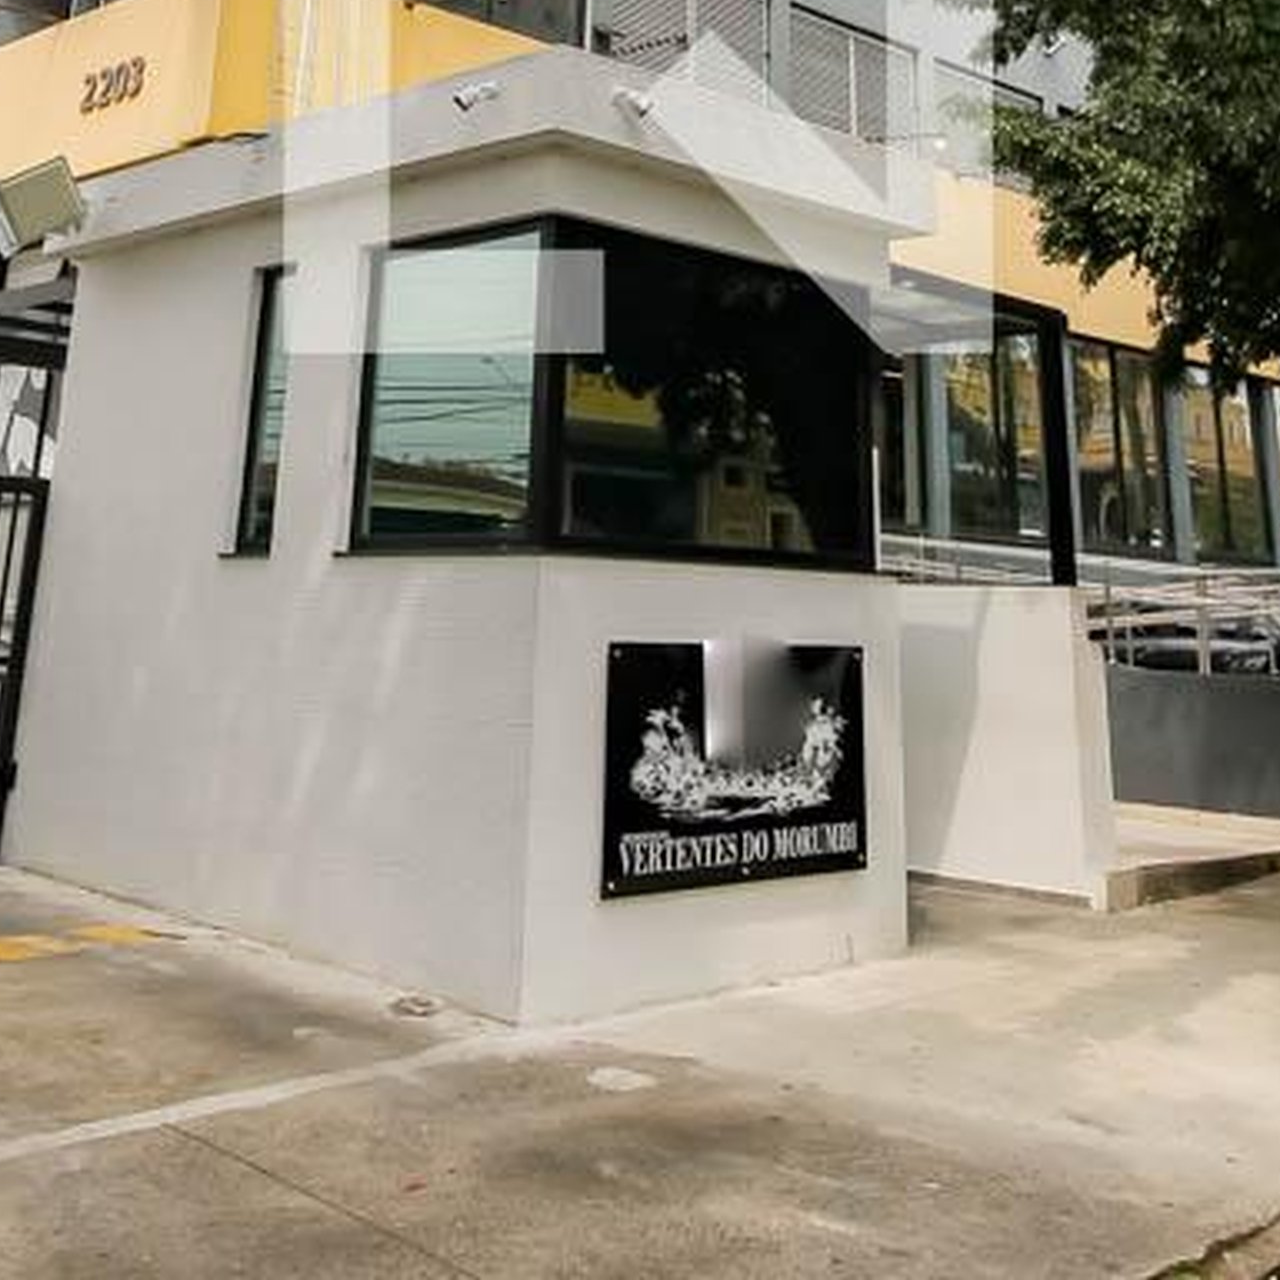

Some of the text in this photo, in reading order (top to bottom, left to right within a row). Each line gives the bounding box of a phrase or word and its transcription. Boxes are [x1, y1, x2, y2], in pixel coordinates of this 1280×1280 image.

[80, 55, 146, 114] 2203
[619, 821, 858, 877] VERTENTES DO MORUMBI
